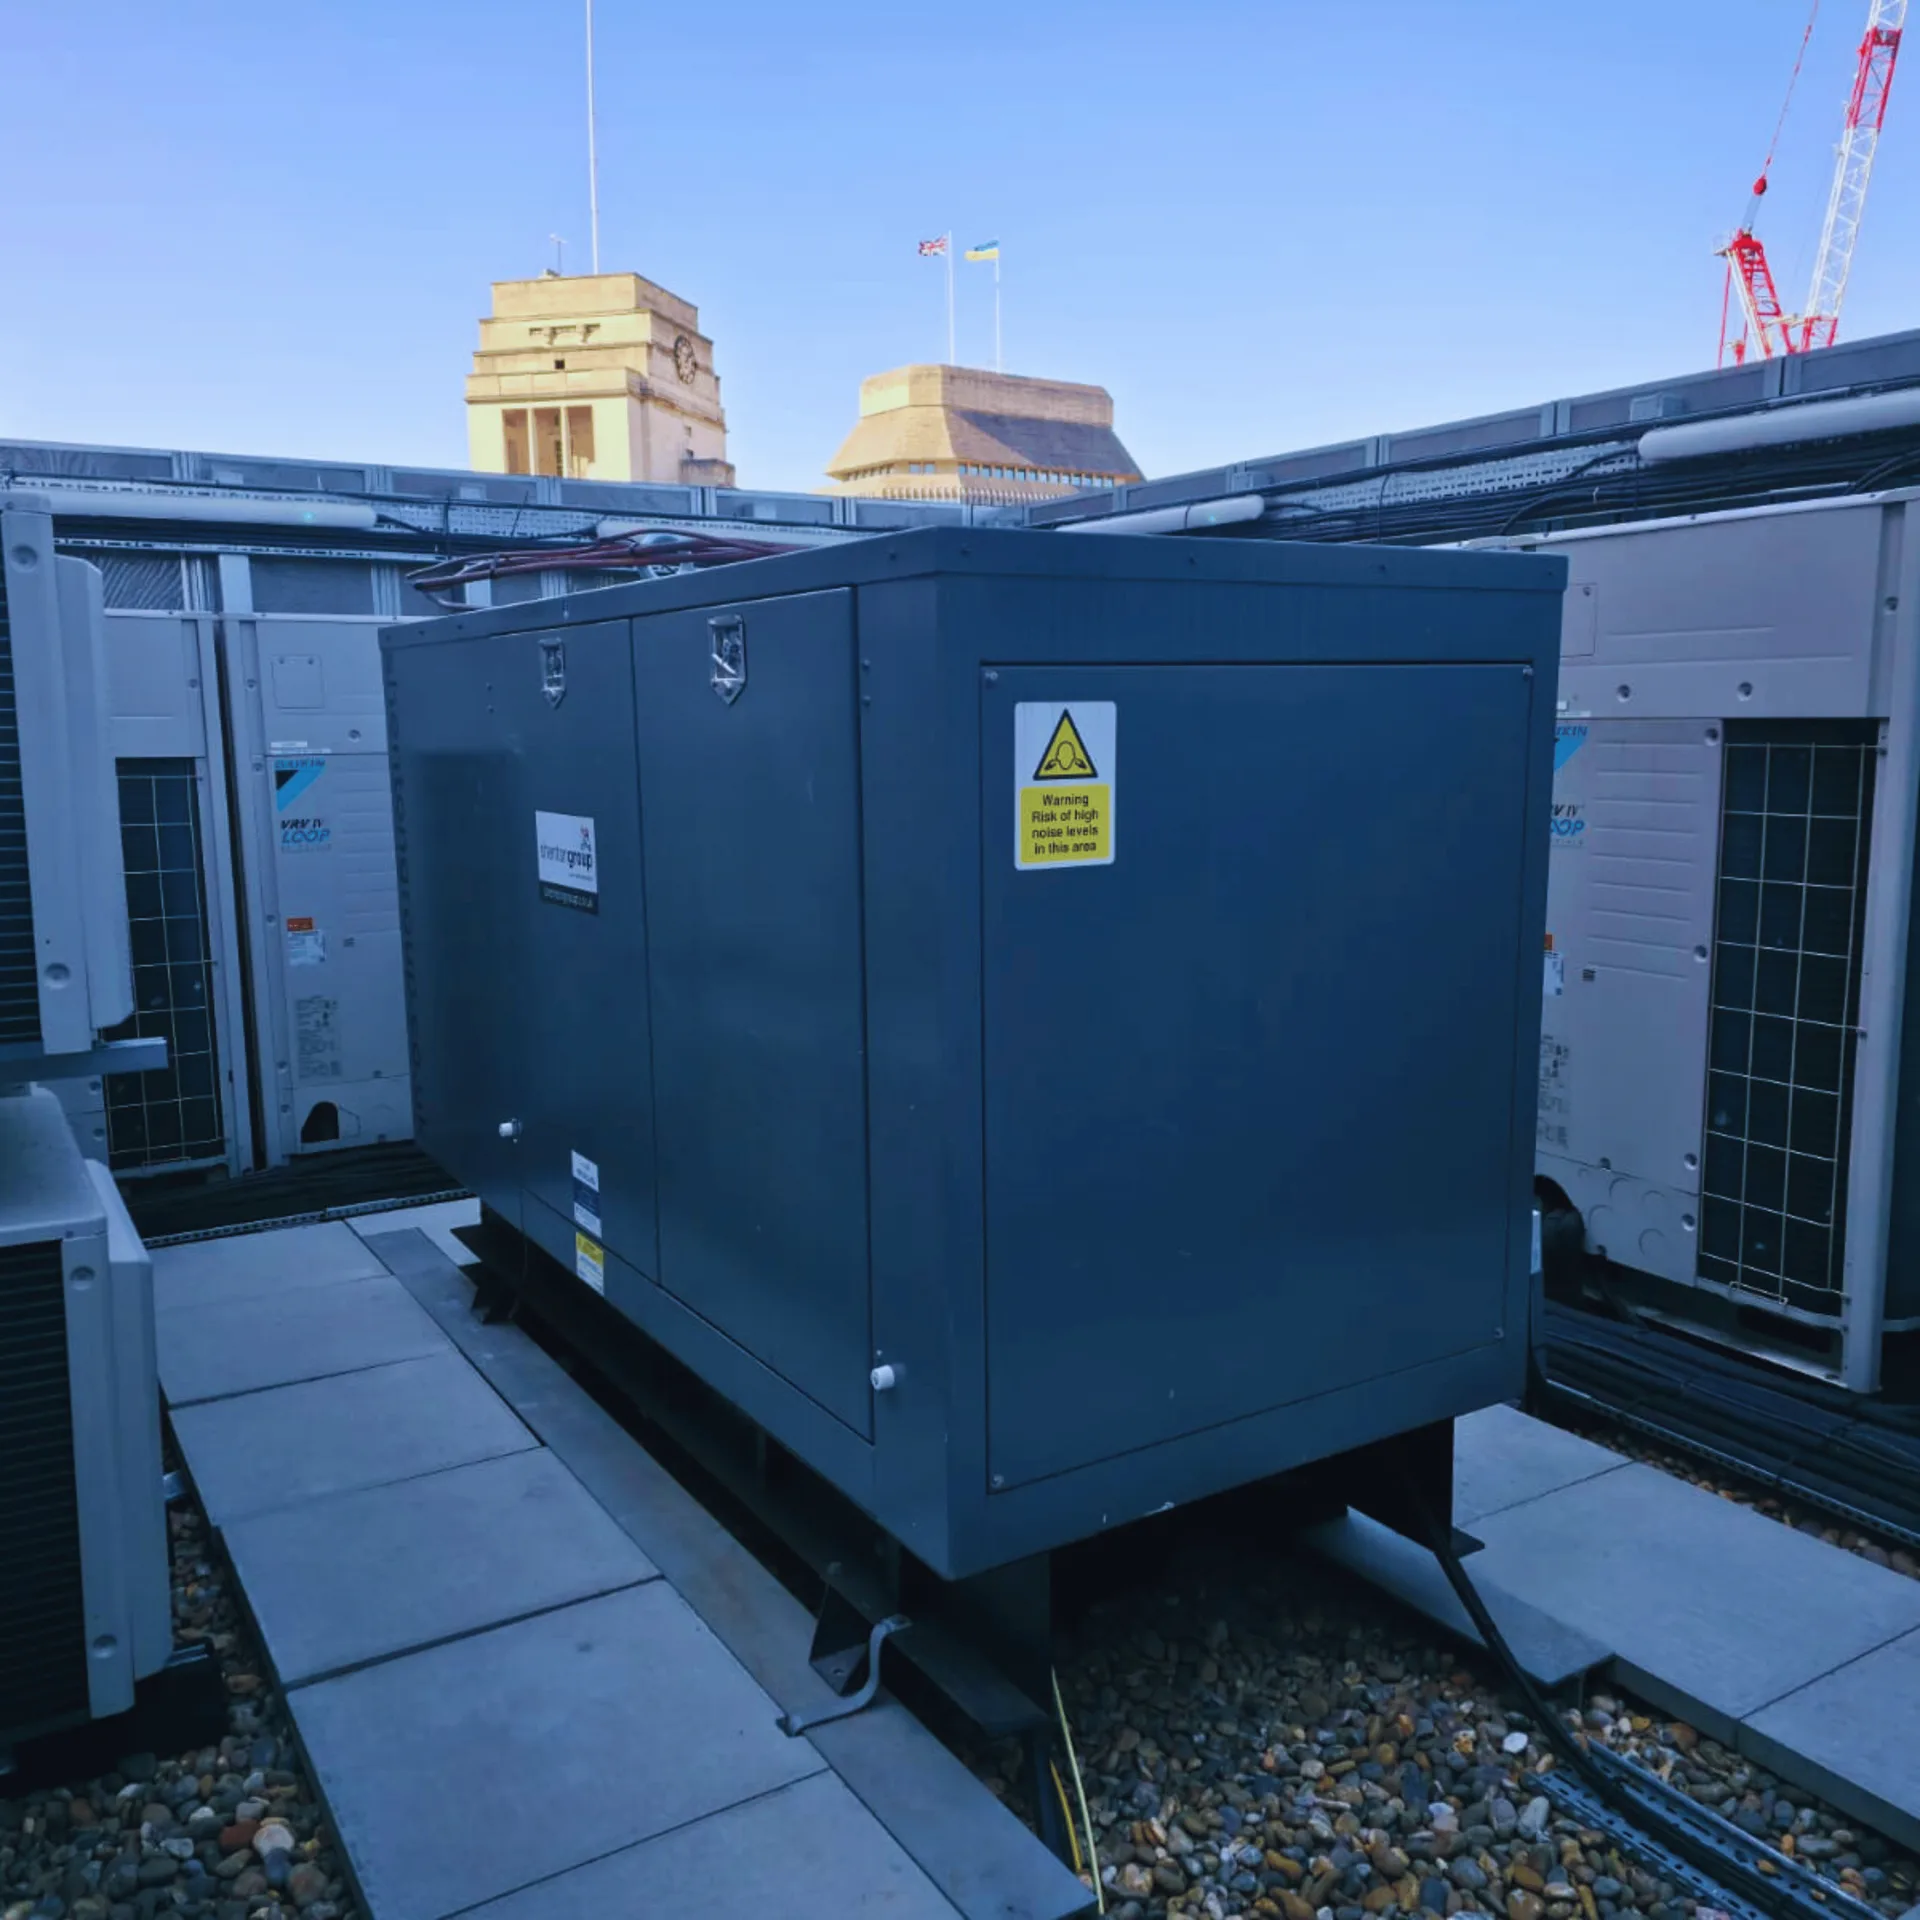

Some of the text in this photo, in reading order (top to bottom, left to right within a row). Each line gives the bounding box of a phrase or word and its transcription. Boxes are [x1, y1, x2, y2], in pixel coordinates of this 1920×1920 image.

[1556, 726, 1588, 737] IKIN
[1042, 794, 1089, 807] Warning
[1032, 809, 1098, 823] Risk of high
[1032, 826, 1098, 839] noise levels
[1048, 842, 1069, 854] this
[1072, 842, 1096, 853] area
